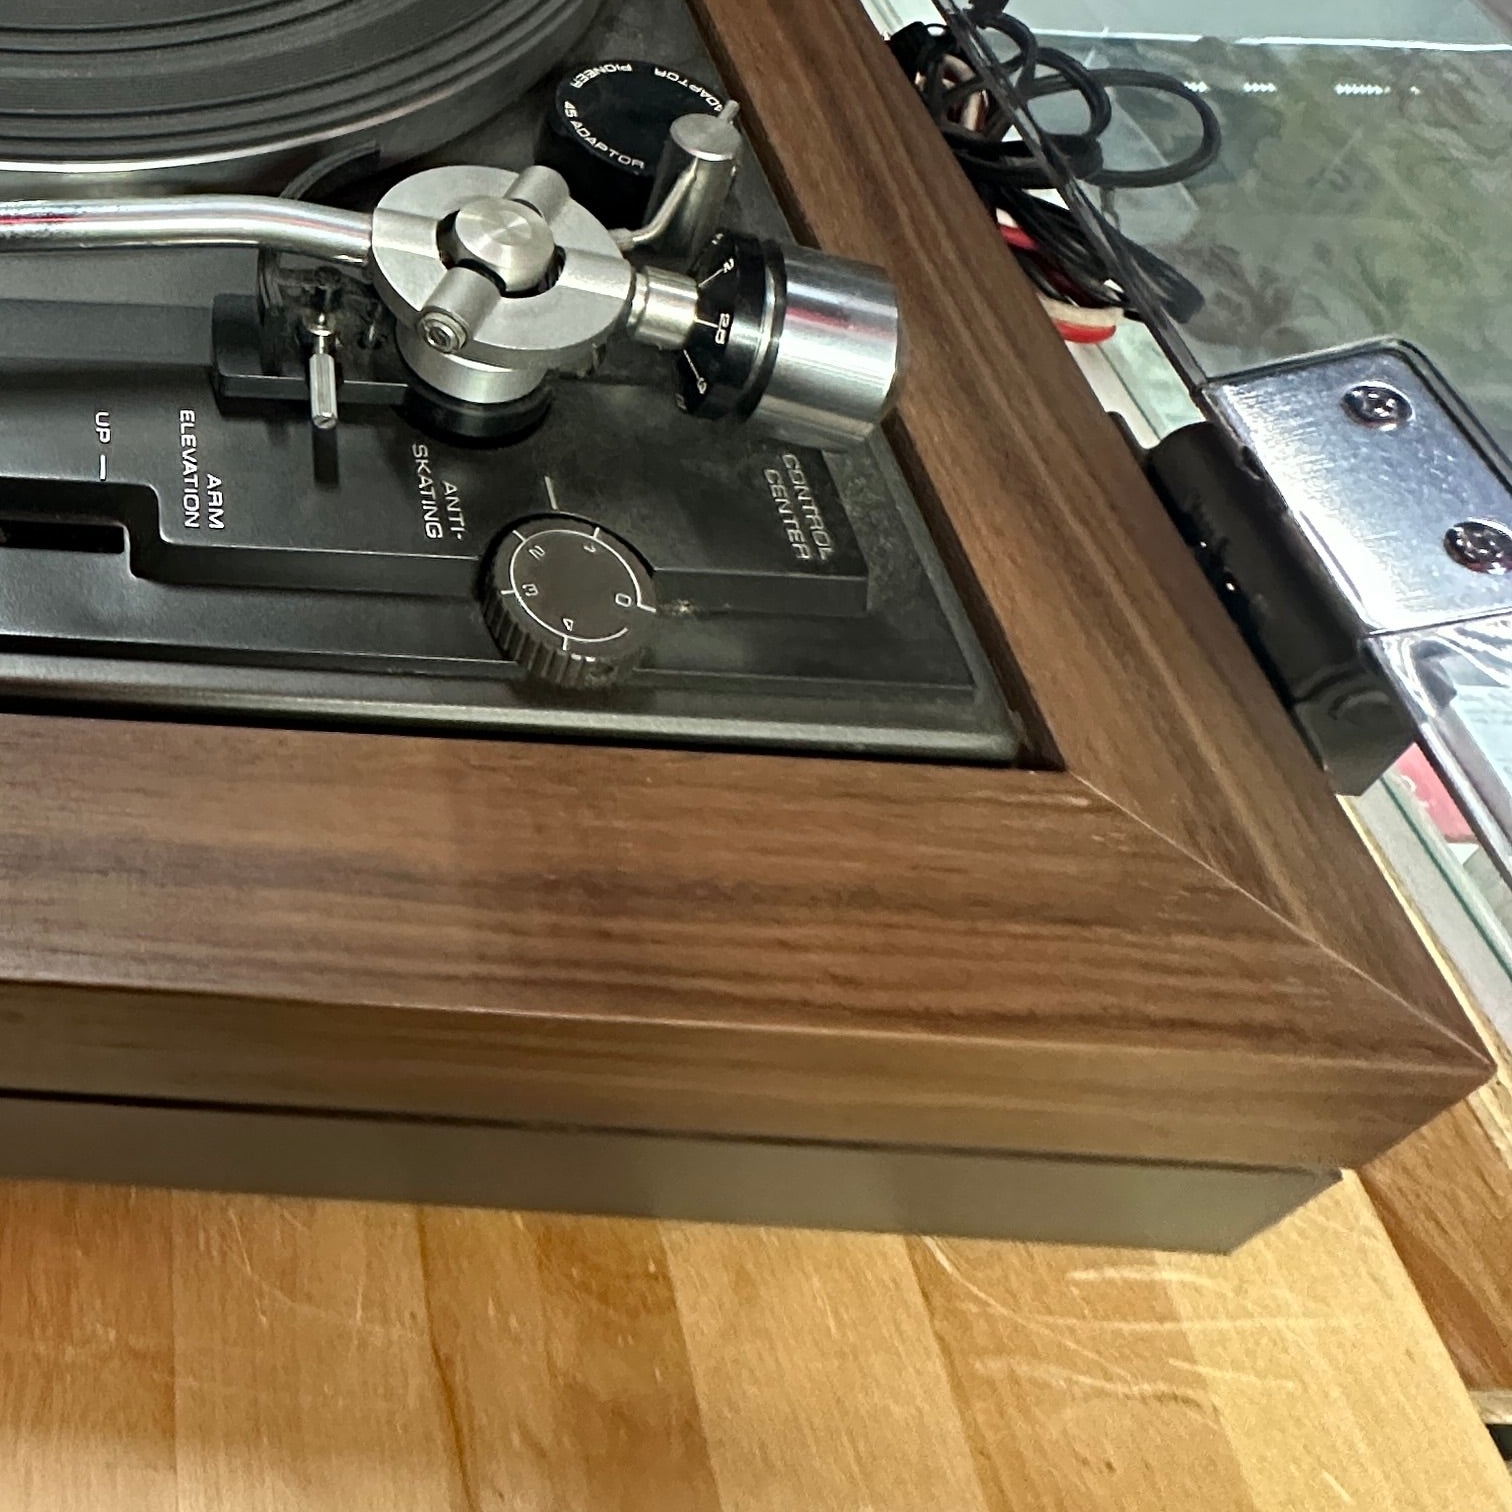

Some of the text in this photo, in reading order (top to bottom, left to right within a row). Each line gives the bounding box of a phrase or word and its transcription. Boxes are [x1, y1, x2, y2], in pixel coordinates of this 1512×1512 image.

[570, 63, 632, 89] PIONEER
[564, 100, 645, 170] 45 ADAPTOR
[723, 258, 735, 273] 2
[95, 411, 111, 443] UP
[179, 409, 200, 529] ELEVATION
[412, 443, 443, 539] SKATING
[206, 473, 225, 529] ARM
[442, 480, 465, 541] ANTI-
[764, 468, 813, 560] CENTER
[782, 454, 835, 561] CONTROL
[528, 545, 546, 561] 2
[522, 584, 539, 597] 3
[562, 617, 574, 631] 4
